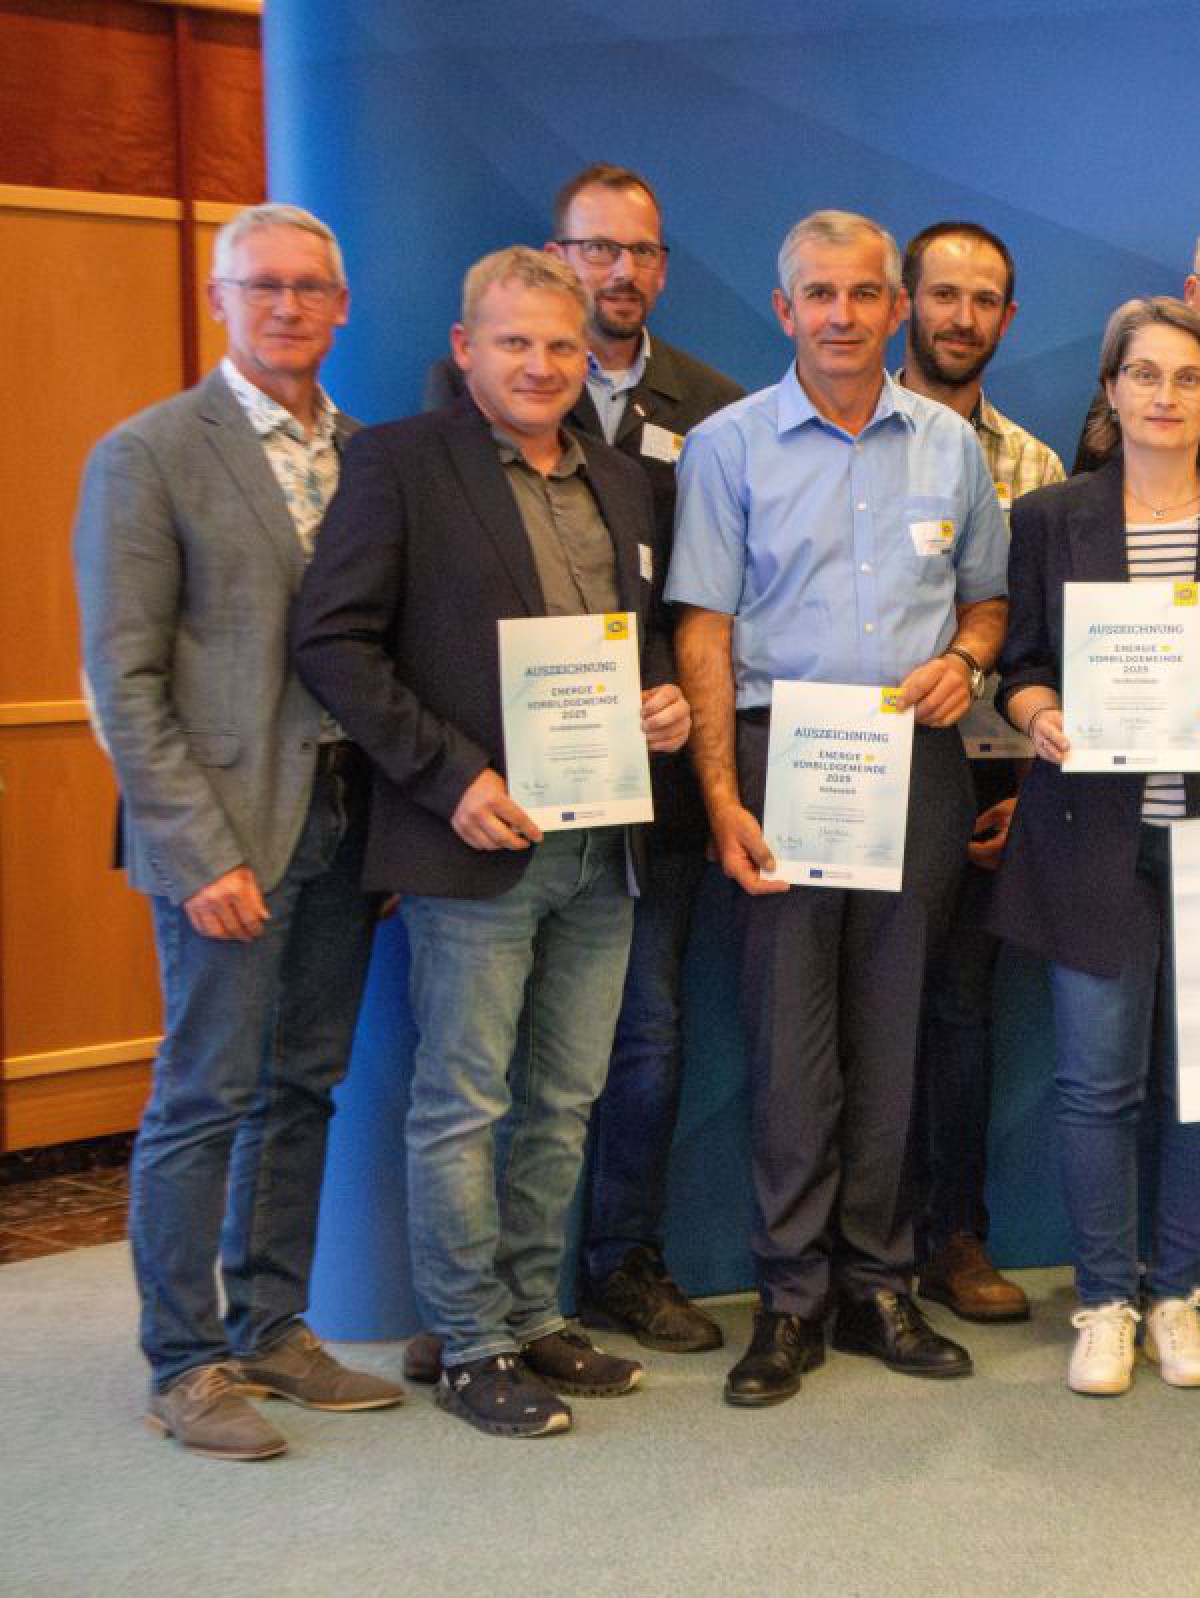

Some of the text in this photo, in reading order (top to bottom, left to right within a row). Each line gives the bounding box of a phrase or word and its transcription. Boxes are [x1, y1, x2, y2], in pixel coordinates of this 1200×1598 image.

[1088, 624, 1184, 634] AUSZEICHNUNG
[524, 661, 617, 676] AUSZEICHNUNG
[794, 727, 889, 743] AUSZEICHNUNG
[819, 750, 861, 761] ENERGIE
[793, 761, 887, 775] VORBILDGEMEINDE
